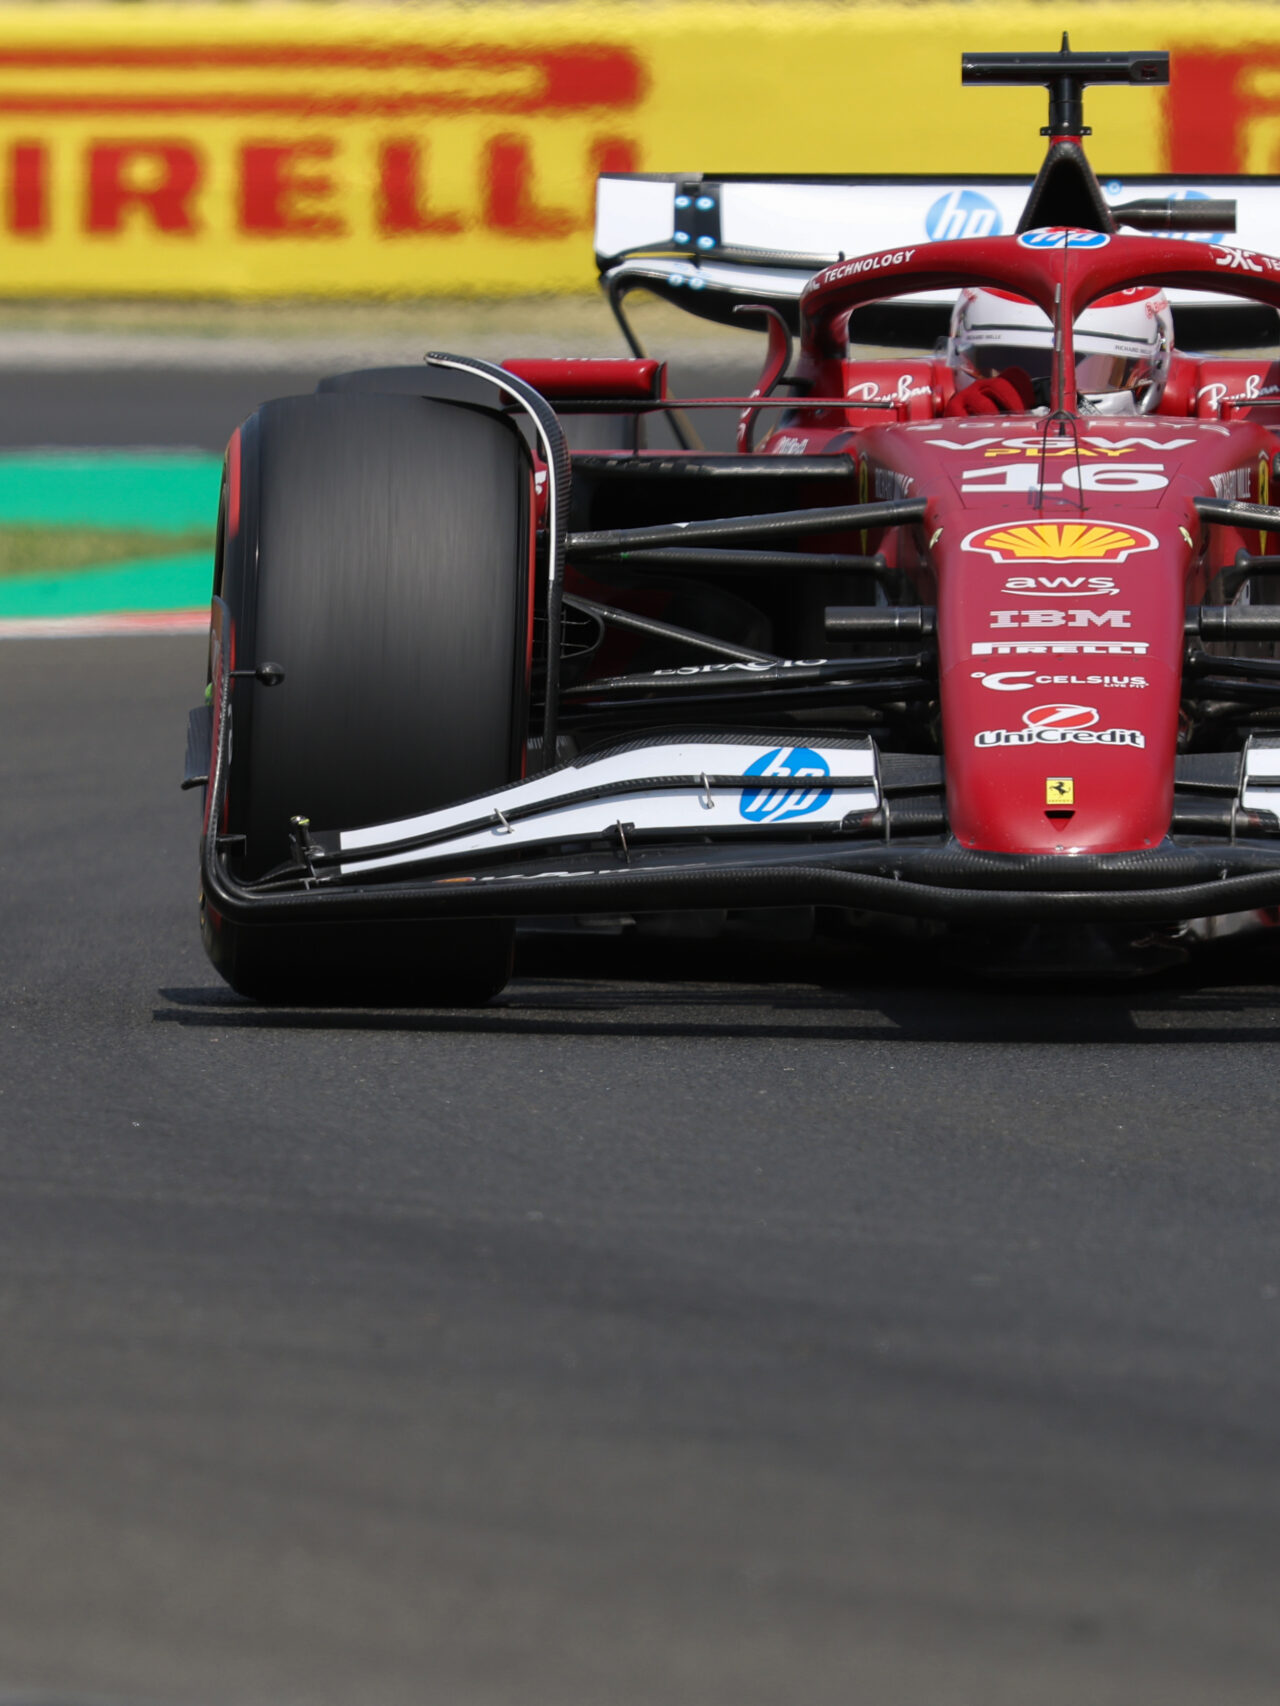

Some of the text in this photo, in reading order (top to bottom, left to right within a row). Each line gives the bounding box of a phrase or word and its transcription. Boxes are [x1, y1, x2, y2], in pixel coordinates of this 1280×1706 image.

[929, 190, 1000, 241] hp
[824, 250, 915, 284] TECHNOLOGY
[924, 437, 1197, 450] VGW
[984, 448, 1136, 457] PLAY
[961, 463, 1169, 492] 16
[1004, 577, 1116, 590] aws
[990, 610, 1131, 628] IBM
[971, 641, 1149, 655] PIRELLI
[1035, 675, 1147, 684] CELSIUS
[976, 728, 1144, 748] UniCredit
[743, 748, 829, 822] hp
